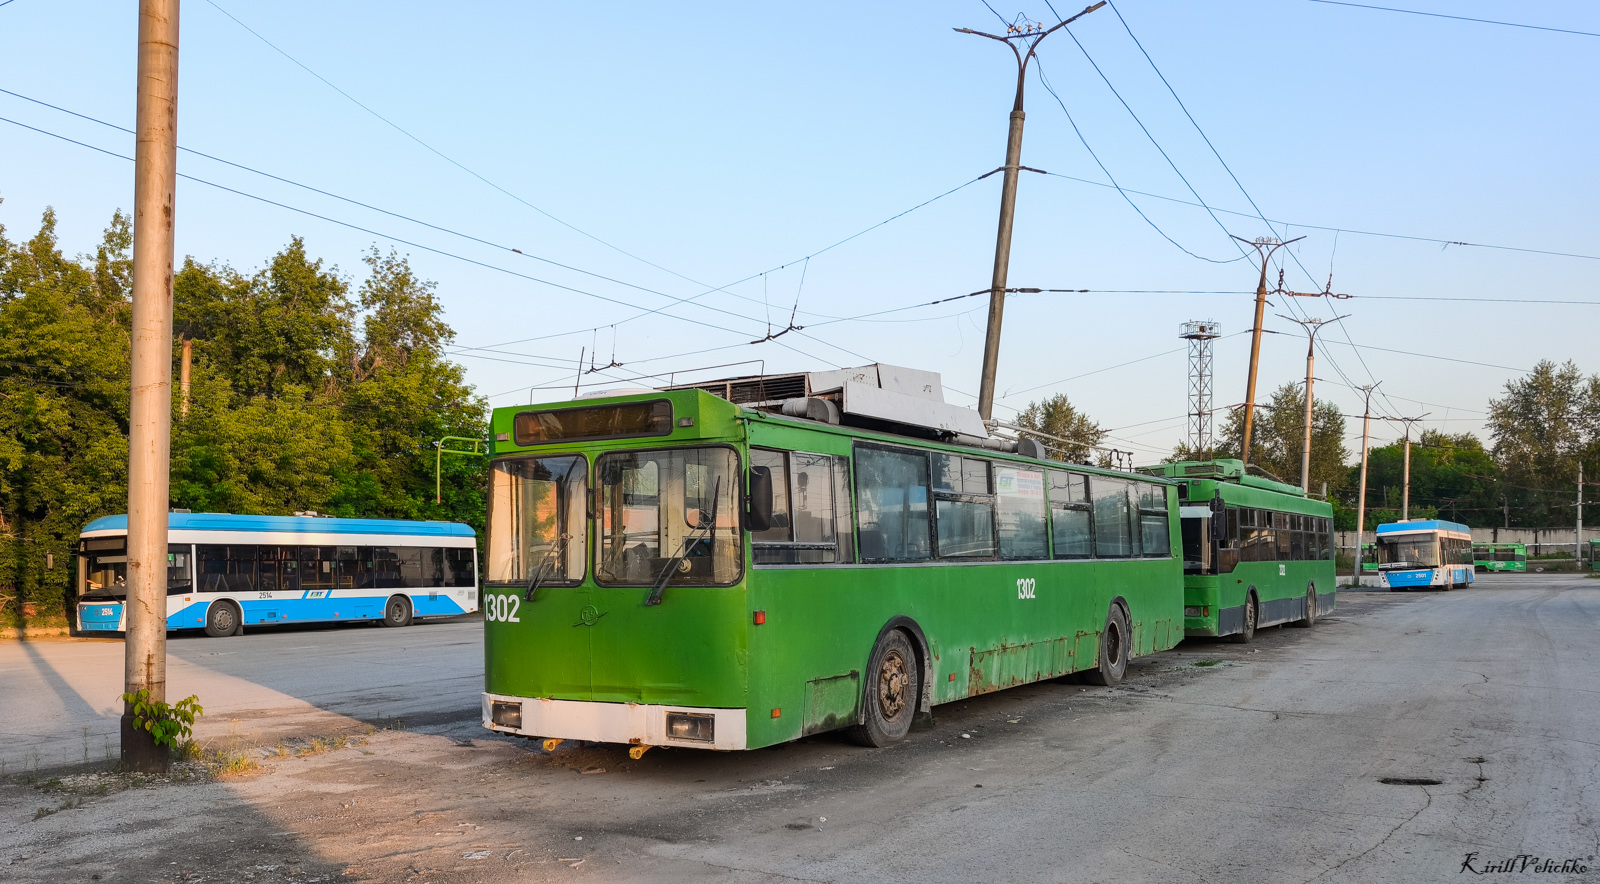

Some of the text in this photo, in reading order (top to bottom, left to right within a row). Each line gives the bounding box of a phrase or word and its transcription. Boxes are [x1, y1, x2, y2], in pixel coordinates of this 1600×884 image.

[1016, 577, 1036, 600] 1302
[101, 608, 113, 616] 2514
[484, 593, 520, 623] 1302
